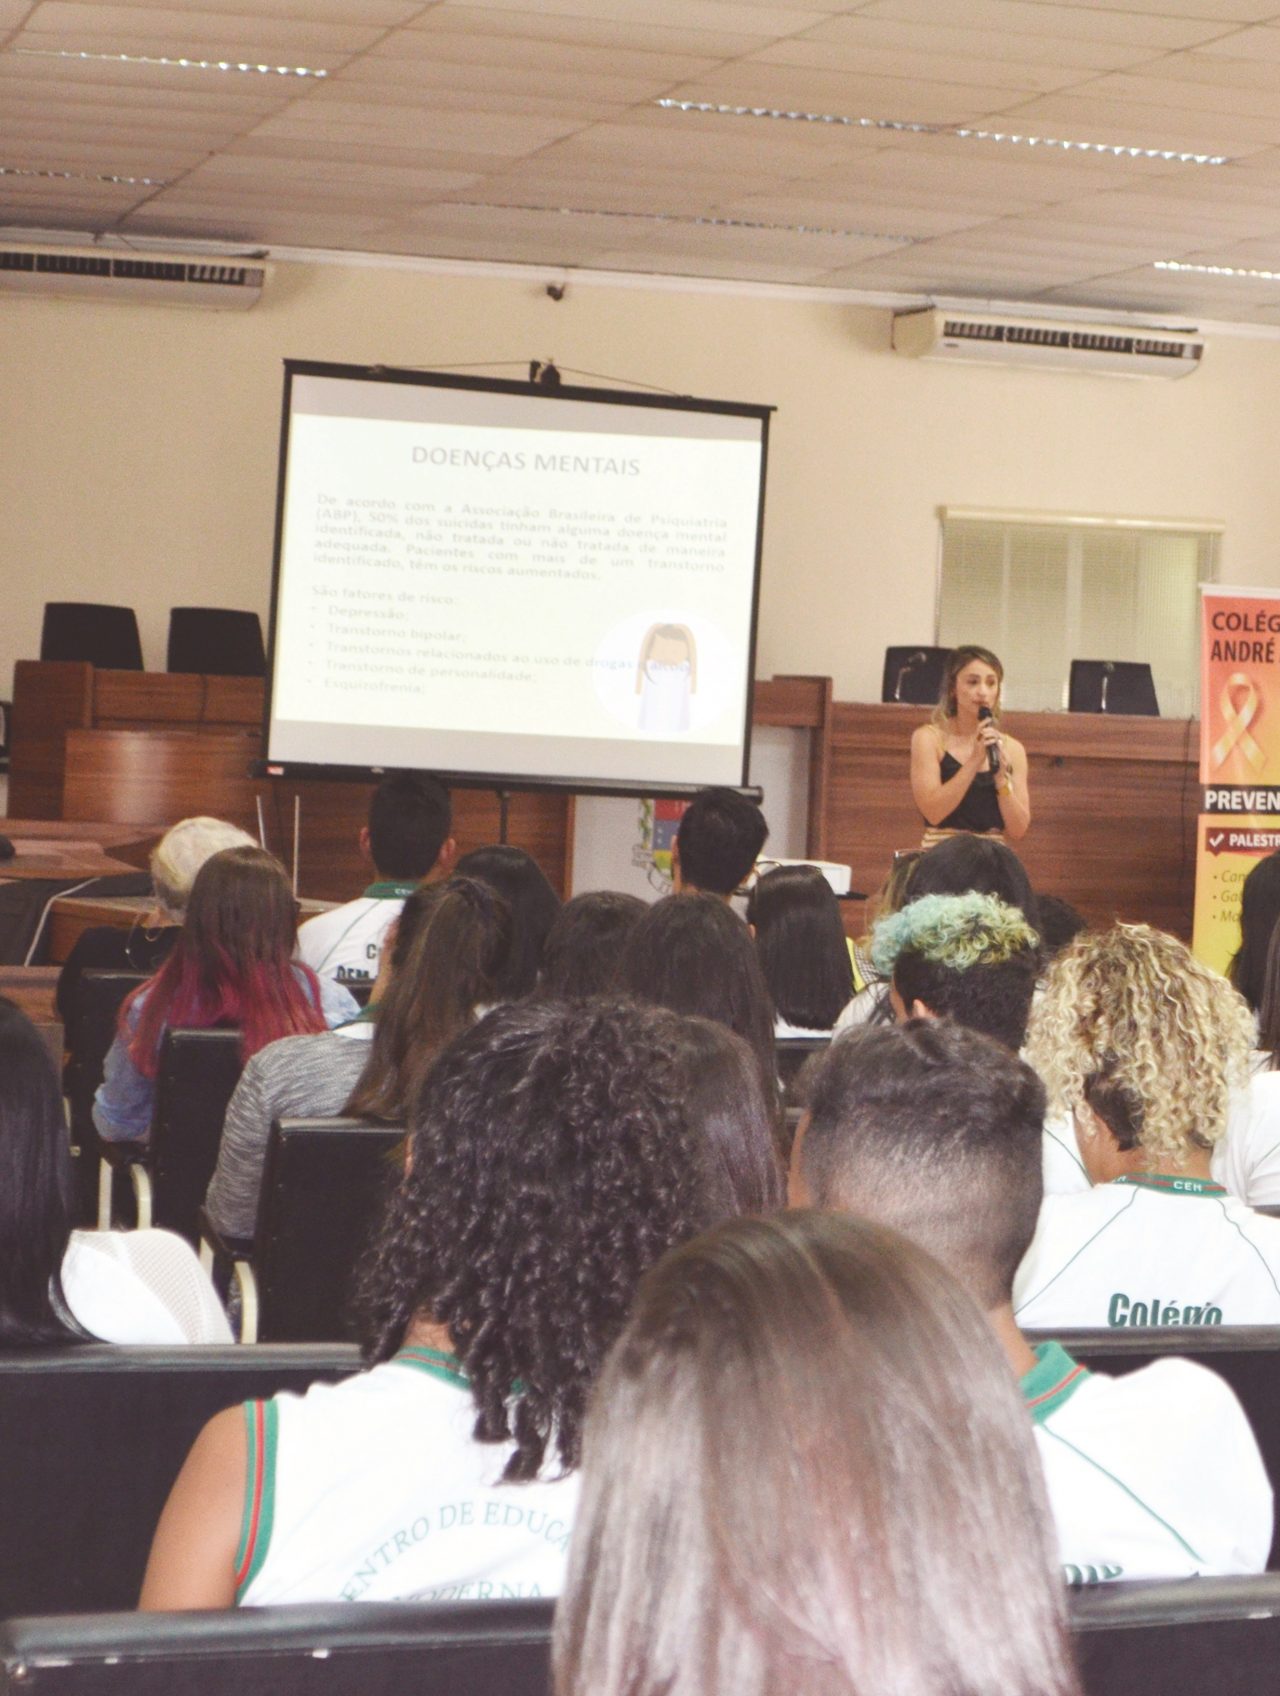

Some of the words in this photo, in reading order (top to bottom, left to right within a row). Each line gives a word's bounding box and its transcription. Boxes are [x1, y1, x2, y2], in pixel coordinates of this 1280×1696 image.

[411, 445, 526, 472] DOENÇAS
[534, 453, 641, 477] MENTAIS
[317, 493, 337, 506] De
[346, 497, 396, 511] acordo
[404, 502, 436, 513] com
[462, 503, 540, 519] Associação
[549, 508, 616, 523] Brasileira
[624, 513, 642, 524] de
[650, 515, 728, 530] Psiquiatria
[404, 513, 431, 526] dos
[437, 517, 494, 531] suicidas
[500, 521, 551, 533] tinham
[558, 523, 611, 538] alguma
[617, 527, 670, 541] doença
[676, 530, 728, 543] mental
[406, 544, 475, 559] Pacientes
[488, 551, 519, 561] com
[532, 552, 566, 564] mais
[579, 555, 597, 566] de
[611, 558, 635, 568] um
[647, 558, 725, 573] transtorno
[415, 530, 443, 542] não
[452, 533, 505, 546] tratada
[513, 538, 533, 548] ou
[541, 537, 568, 550] não
[577, 540, 630, 553] tratada
[639, 543, 657, 554] de
[666, 546, 726, 559] maneira
[409, 559, 438, 571] têm
[442, 562, 459, 573] os
[462, 563, 502, 576] riscos
[312, 585, 338, 598] São
[343, 588, 394, 602] fatores
[398, 591, 416, 603] de
[328, 622, 406, 639] Transtorno
[327, 641, 411, 657] Transtornos
[416, 647, 508, 663] relacionados
[512, 655, 530, 665] ao
[535, 657, 559, 666] uso
[563, 655, 581, 667] de
[585, 657, 634, 671] drogas
[1210, 638, 1275, 663] ANDRÉ
[326, 658, 405, 675] Transtorno
[408, 664, 426, 676] de
[1173, 1180, 1202, 1192] CEM
[339, 1515, 431, 1601] ENTRO
[439, 1502, 475, 1531] DE
[483, 1502, 573, 1554] EDUCA
